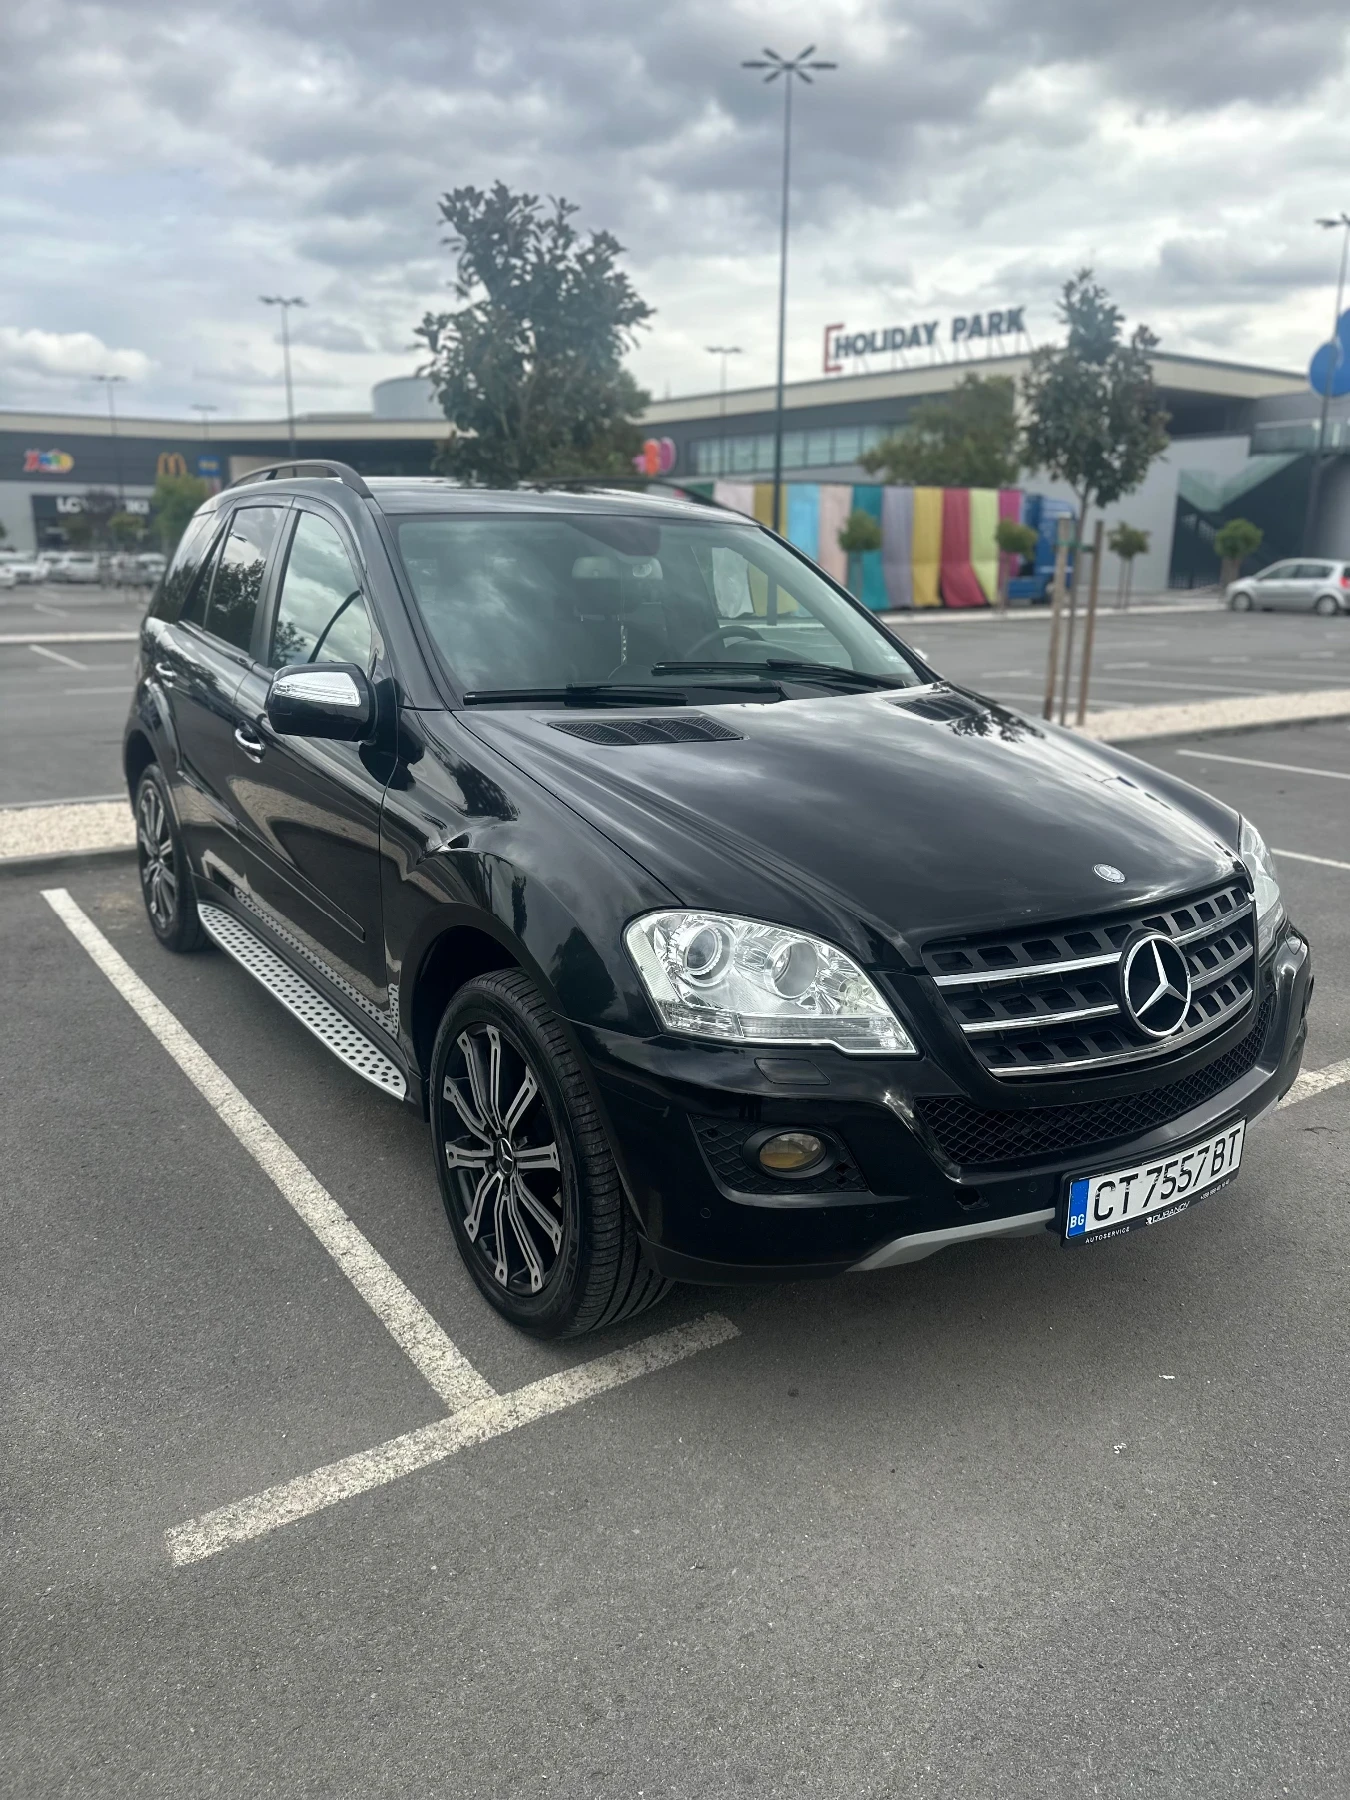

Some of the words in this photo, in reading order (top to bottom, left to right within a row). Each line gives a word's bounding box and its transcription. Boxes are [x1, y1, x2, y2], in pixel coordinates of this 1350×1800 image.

[834, 319, 939, 359] HOLIDAY
[951, 306, 1026, 342] PARK
[1070, 1213, 1086, 1229] BG
[1085, 1226, 1130, 1244] AUTOSERVICE
